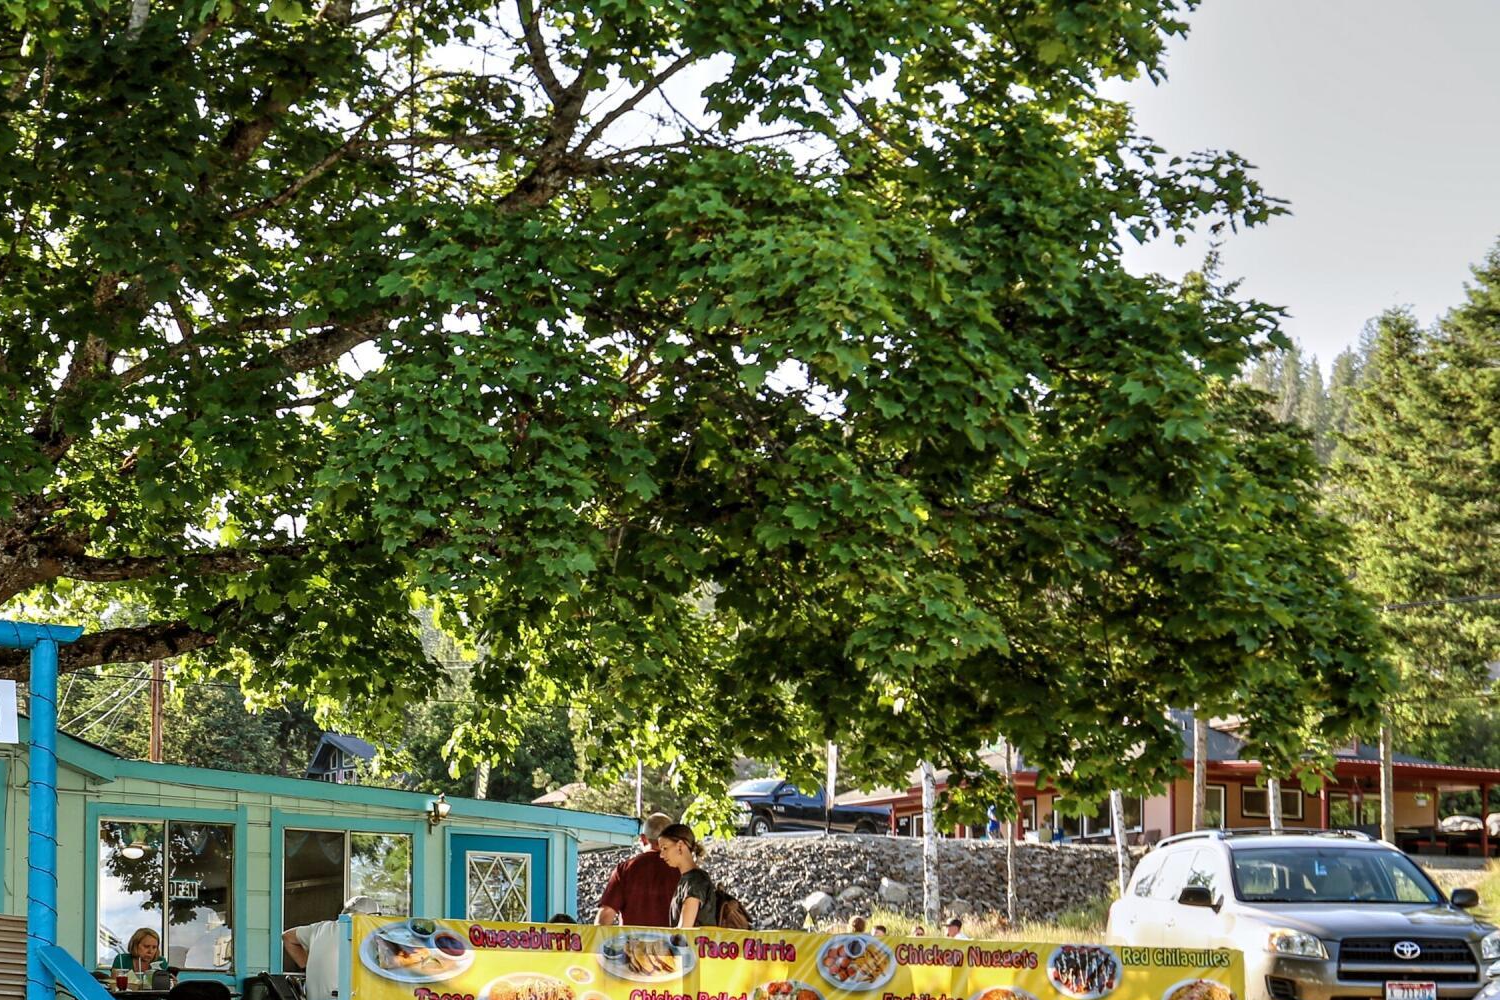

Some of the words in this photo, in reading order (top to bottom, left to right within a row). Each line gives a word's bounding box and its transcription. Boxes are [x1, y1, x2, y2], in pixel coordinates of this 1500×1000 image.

[468, 924, 582, 951] Quesabirria
[695, 935, 738, 959] Taco
[742, 938, 796, 962] Birria
[895, 944, 964, 967] Chicken
[967, 946, 1038, 968] Nuggets
[1121, 948, 1149, 965] Red
[1153, 949, 1230, 968] Chilaquiles
